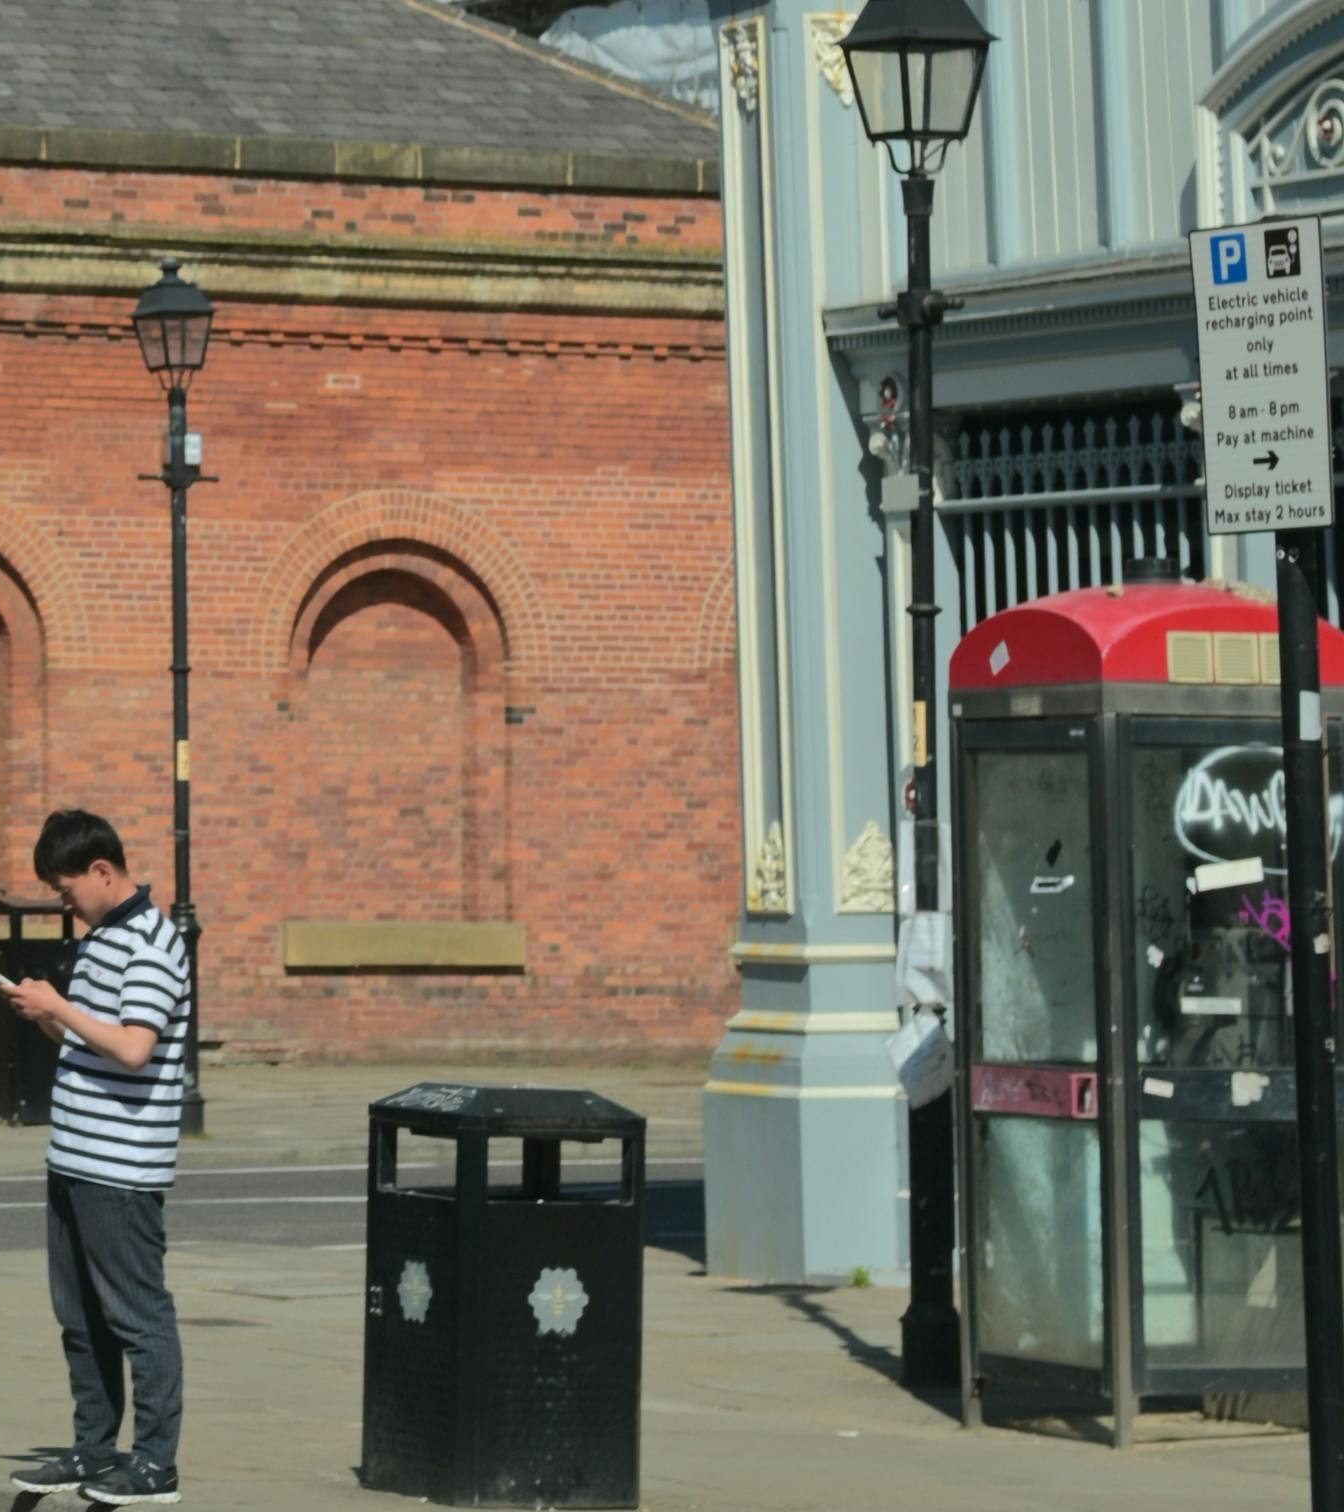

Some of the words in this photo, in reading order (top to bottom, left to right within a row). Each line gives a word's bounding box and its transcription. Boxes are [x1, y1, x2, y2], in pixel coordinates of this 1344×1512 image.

[1218, 239, 1241, 280] P
[1208, 293, 1258, 311] Electric
[1263, 287, 1308, 305] vehicle
[1206, 311, 1274, 331] recharging
[1280, 307, 1313, 326] point
[1246, 337, 1274, 354] only
[1226, 364, 1238, 380] at
[1243, 363, 1259, 380] all
[1263, 362, 1298, 377] times
[1240, 406, 1258, 419] am
[1281, 403, 1299, 417] pm
[1217, 432, 1239, 448] Pay
[1244, 430, 1256, 444] at
[1261, 426, 1314, 441] machine
[1225, 483, 1270, 499] Display
[1275, 478, 1312, 495] ticket
[1215, 509, 1240, 524] Max
[1245, 509, 1271, 524] stay
[1276, 505, 1283, 520] 2
[1289, 504, 1325, 518] hours
